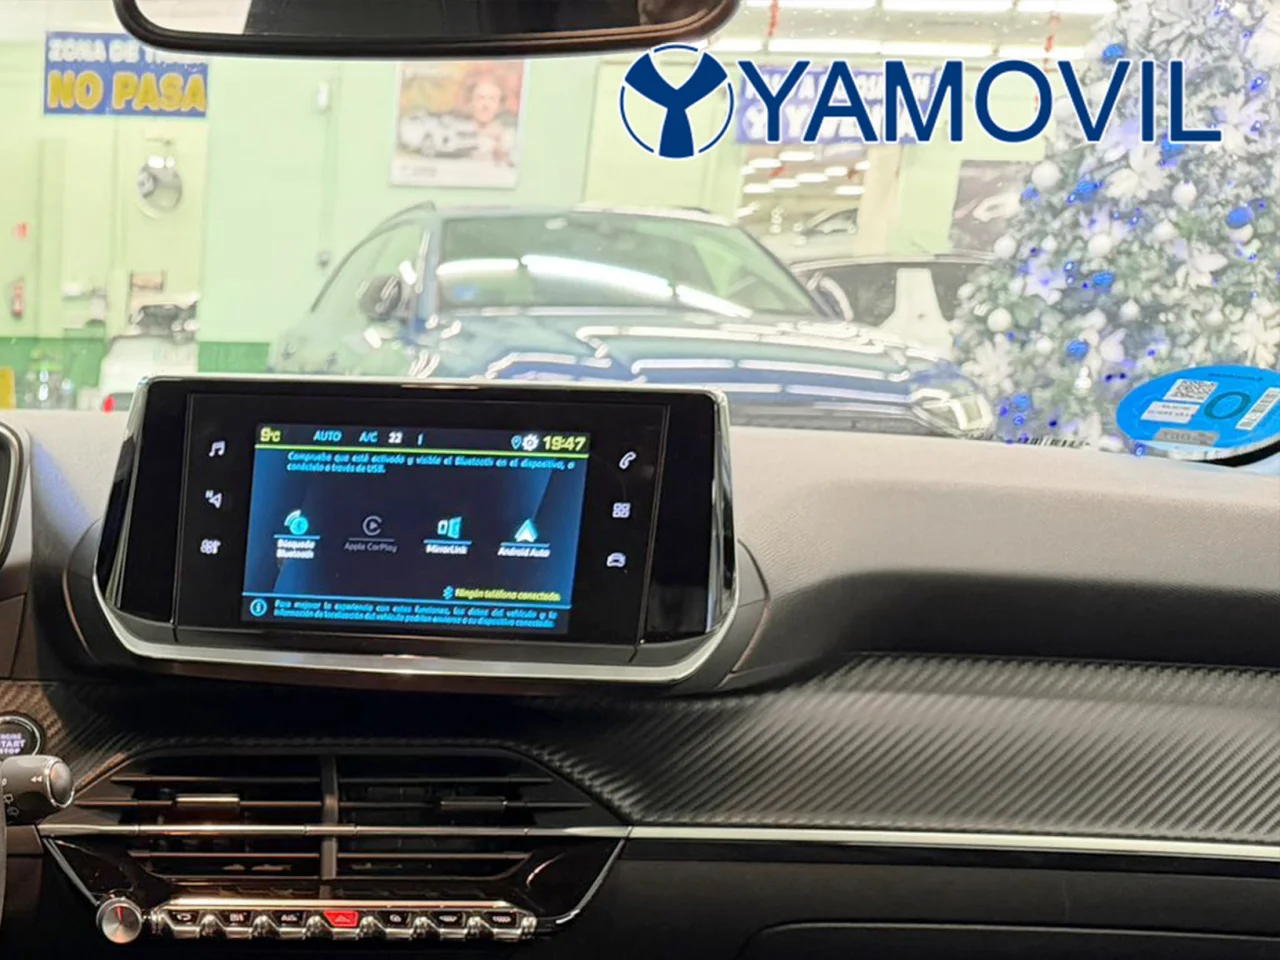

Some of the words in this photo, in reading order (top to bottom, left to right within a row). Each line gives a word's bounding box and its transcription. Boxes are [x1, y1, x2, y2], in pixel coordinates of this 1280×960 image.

[47, 70, 104, 110] NO
[111, 71, 206, 112] PASA
[313, 430, 342, 442] AUTO
[359, 431, 378, 443] A/C
[388, 431, 403, 443] 22
[543, 435, 586, 451] 19:47
[344, 542, 365, 551] Apple
[367, 542, 397, 553] CarPlay
[497, 547, 529, 557] Android
[530, 548, 550, 558] Auto
